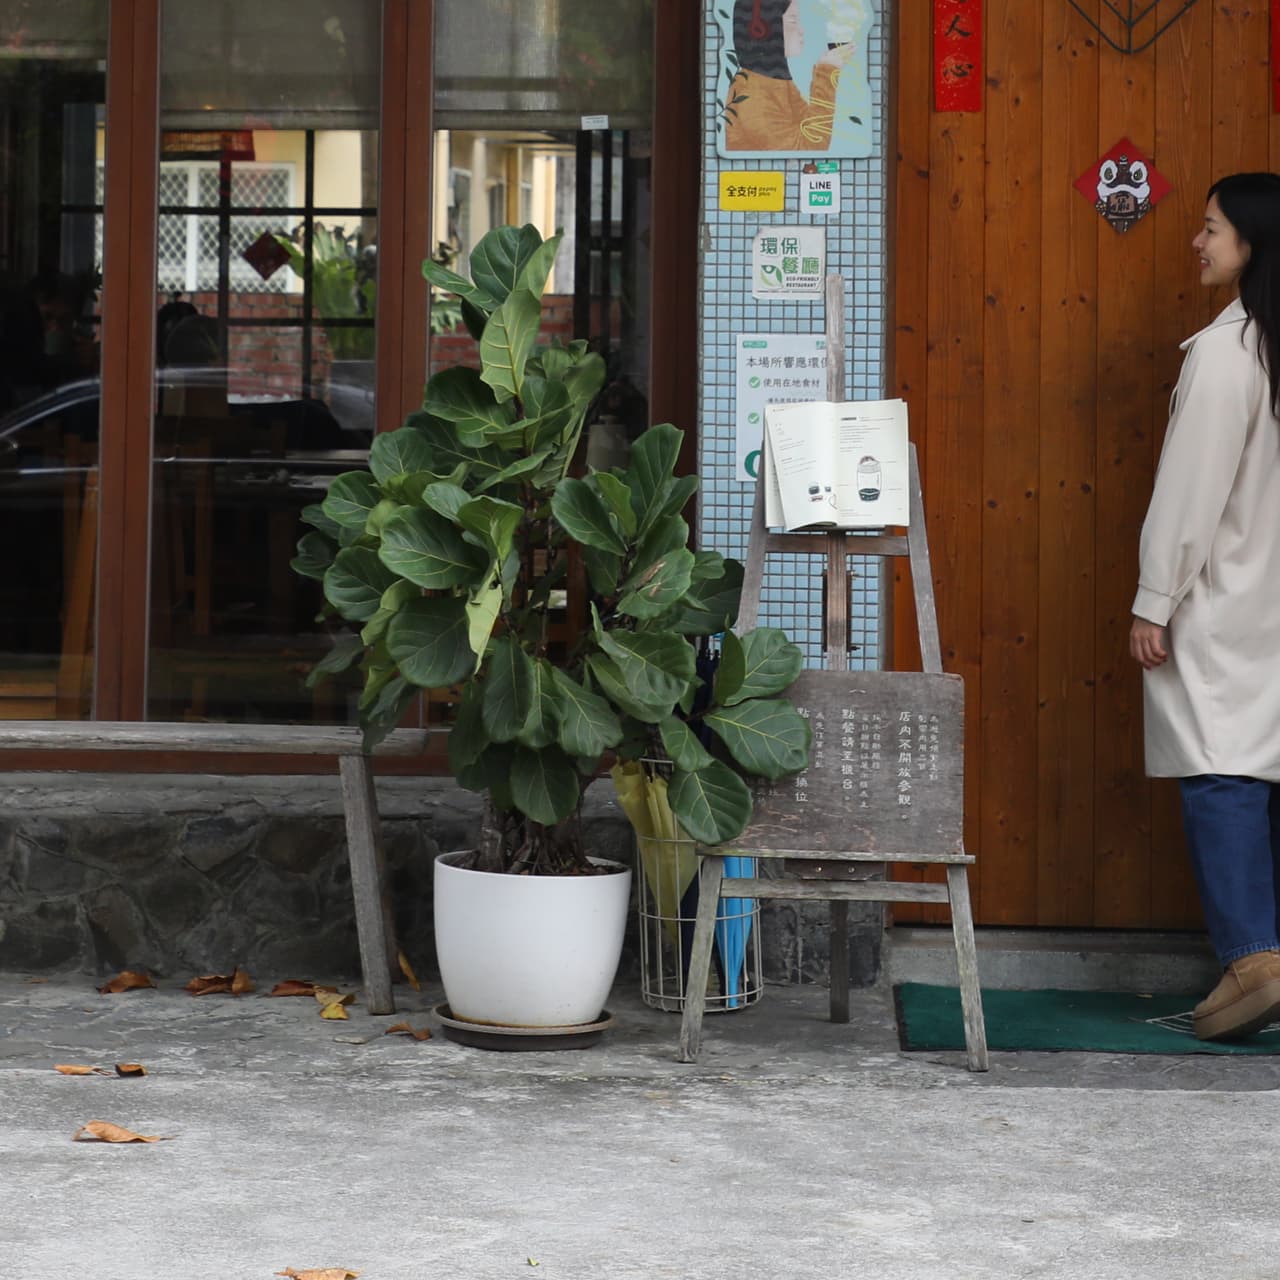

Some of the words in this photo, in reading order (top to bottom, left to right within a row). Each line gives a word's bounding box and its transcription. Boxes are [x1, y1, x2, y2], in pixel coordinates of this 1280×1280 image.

[726, 185, 758, 198] 全支付
[809, 181, 832, 190] LINE
[811, 194, 831, 204] Pay
[760, 237, 798, 255] 環保
[782, 256, 820, 275] 餐廳
[763, 377, 821, 389] 使用在地食材
